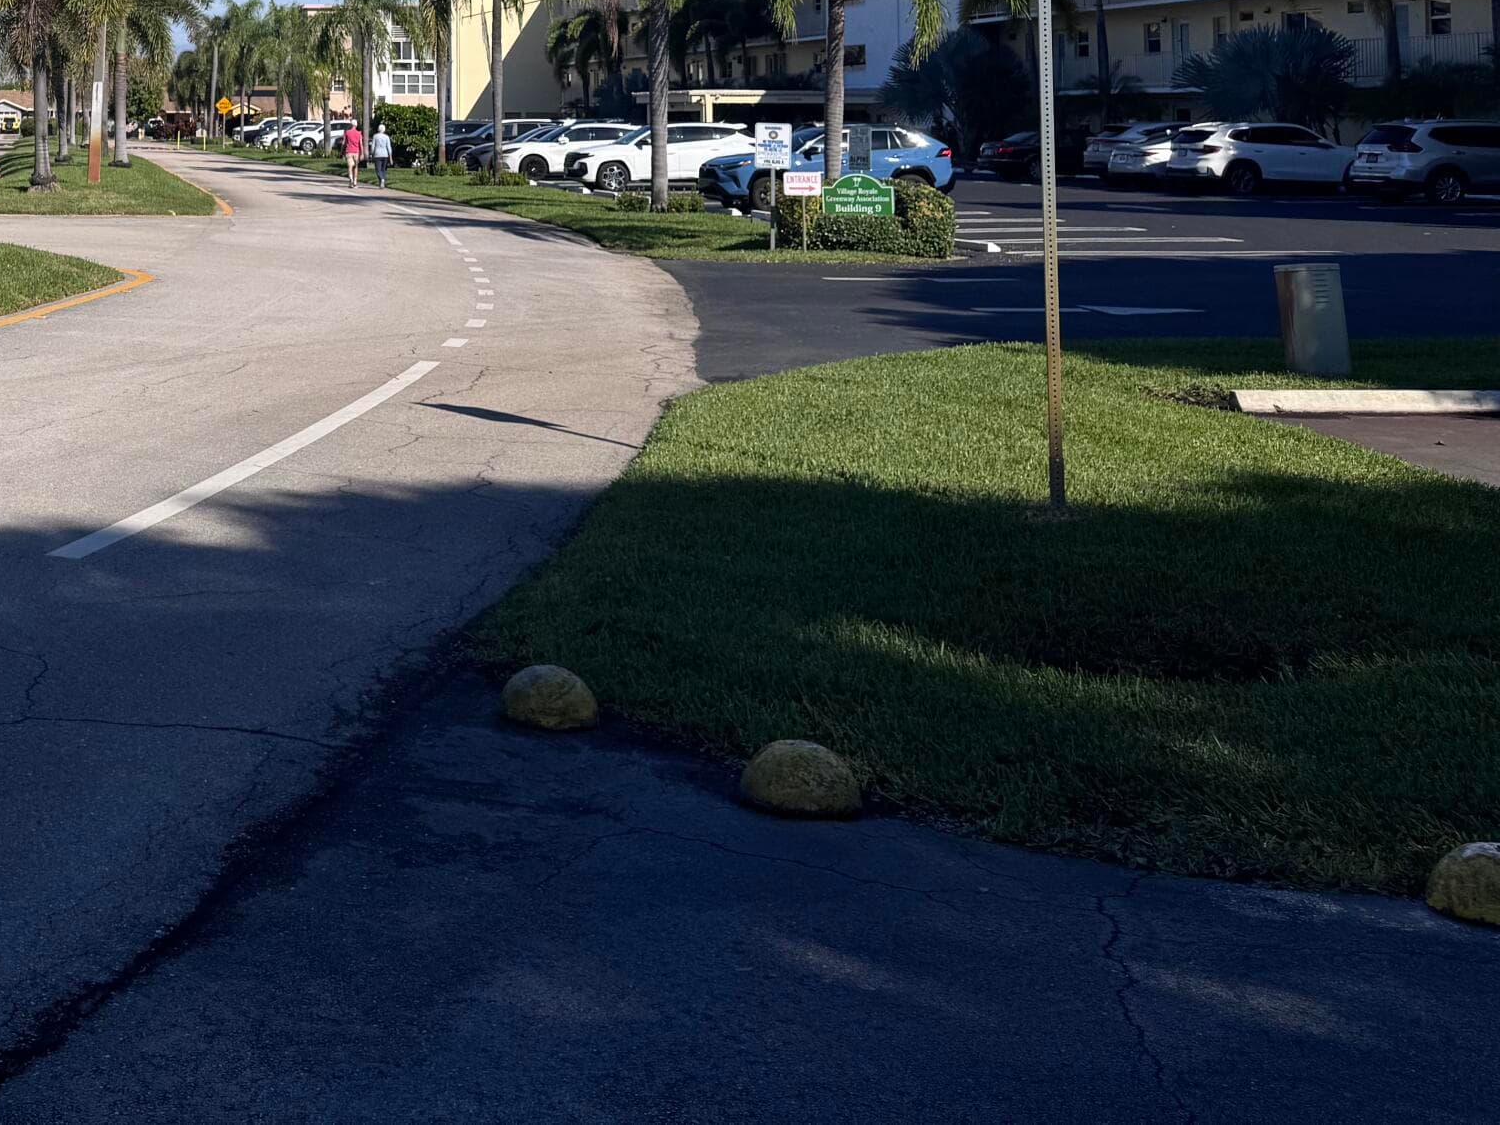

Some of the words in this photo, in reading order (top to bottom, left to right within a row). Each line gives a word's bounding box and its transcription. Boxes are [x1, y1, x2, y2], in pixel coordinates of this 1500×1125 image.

[786, 175, 818, 184] ENTRANCE
[837, 188, 857, 196] Village
[858, 188, 878, 196] Royale
[826, 195, 855, 203] Greenway
[835, 204, 873, 214] Building
[875, 204, 882, 213] 9
